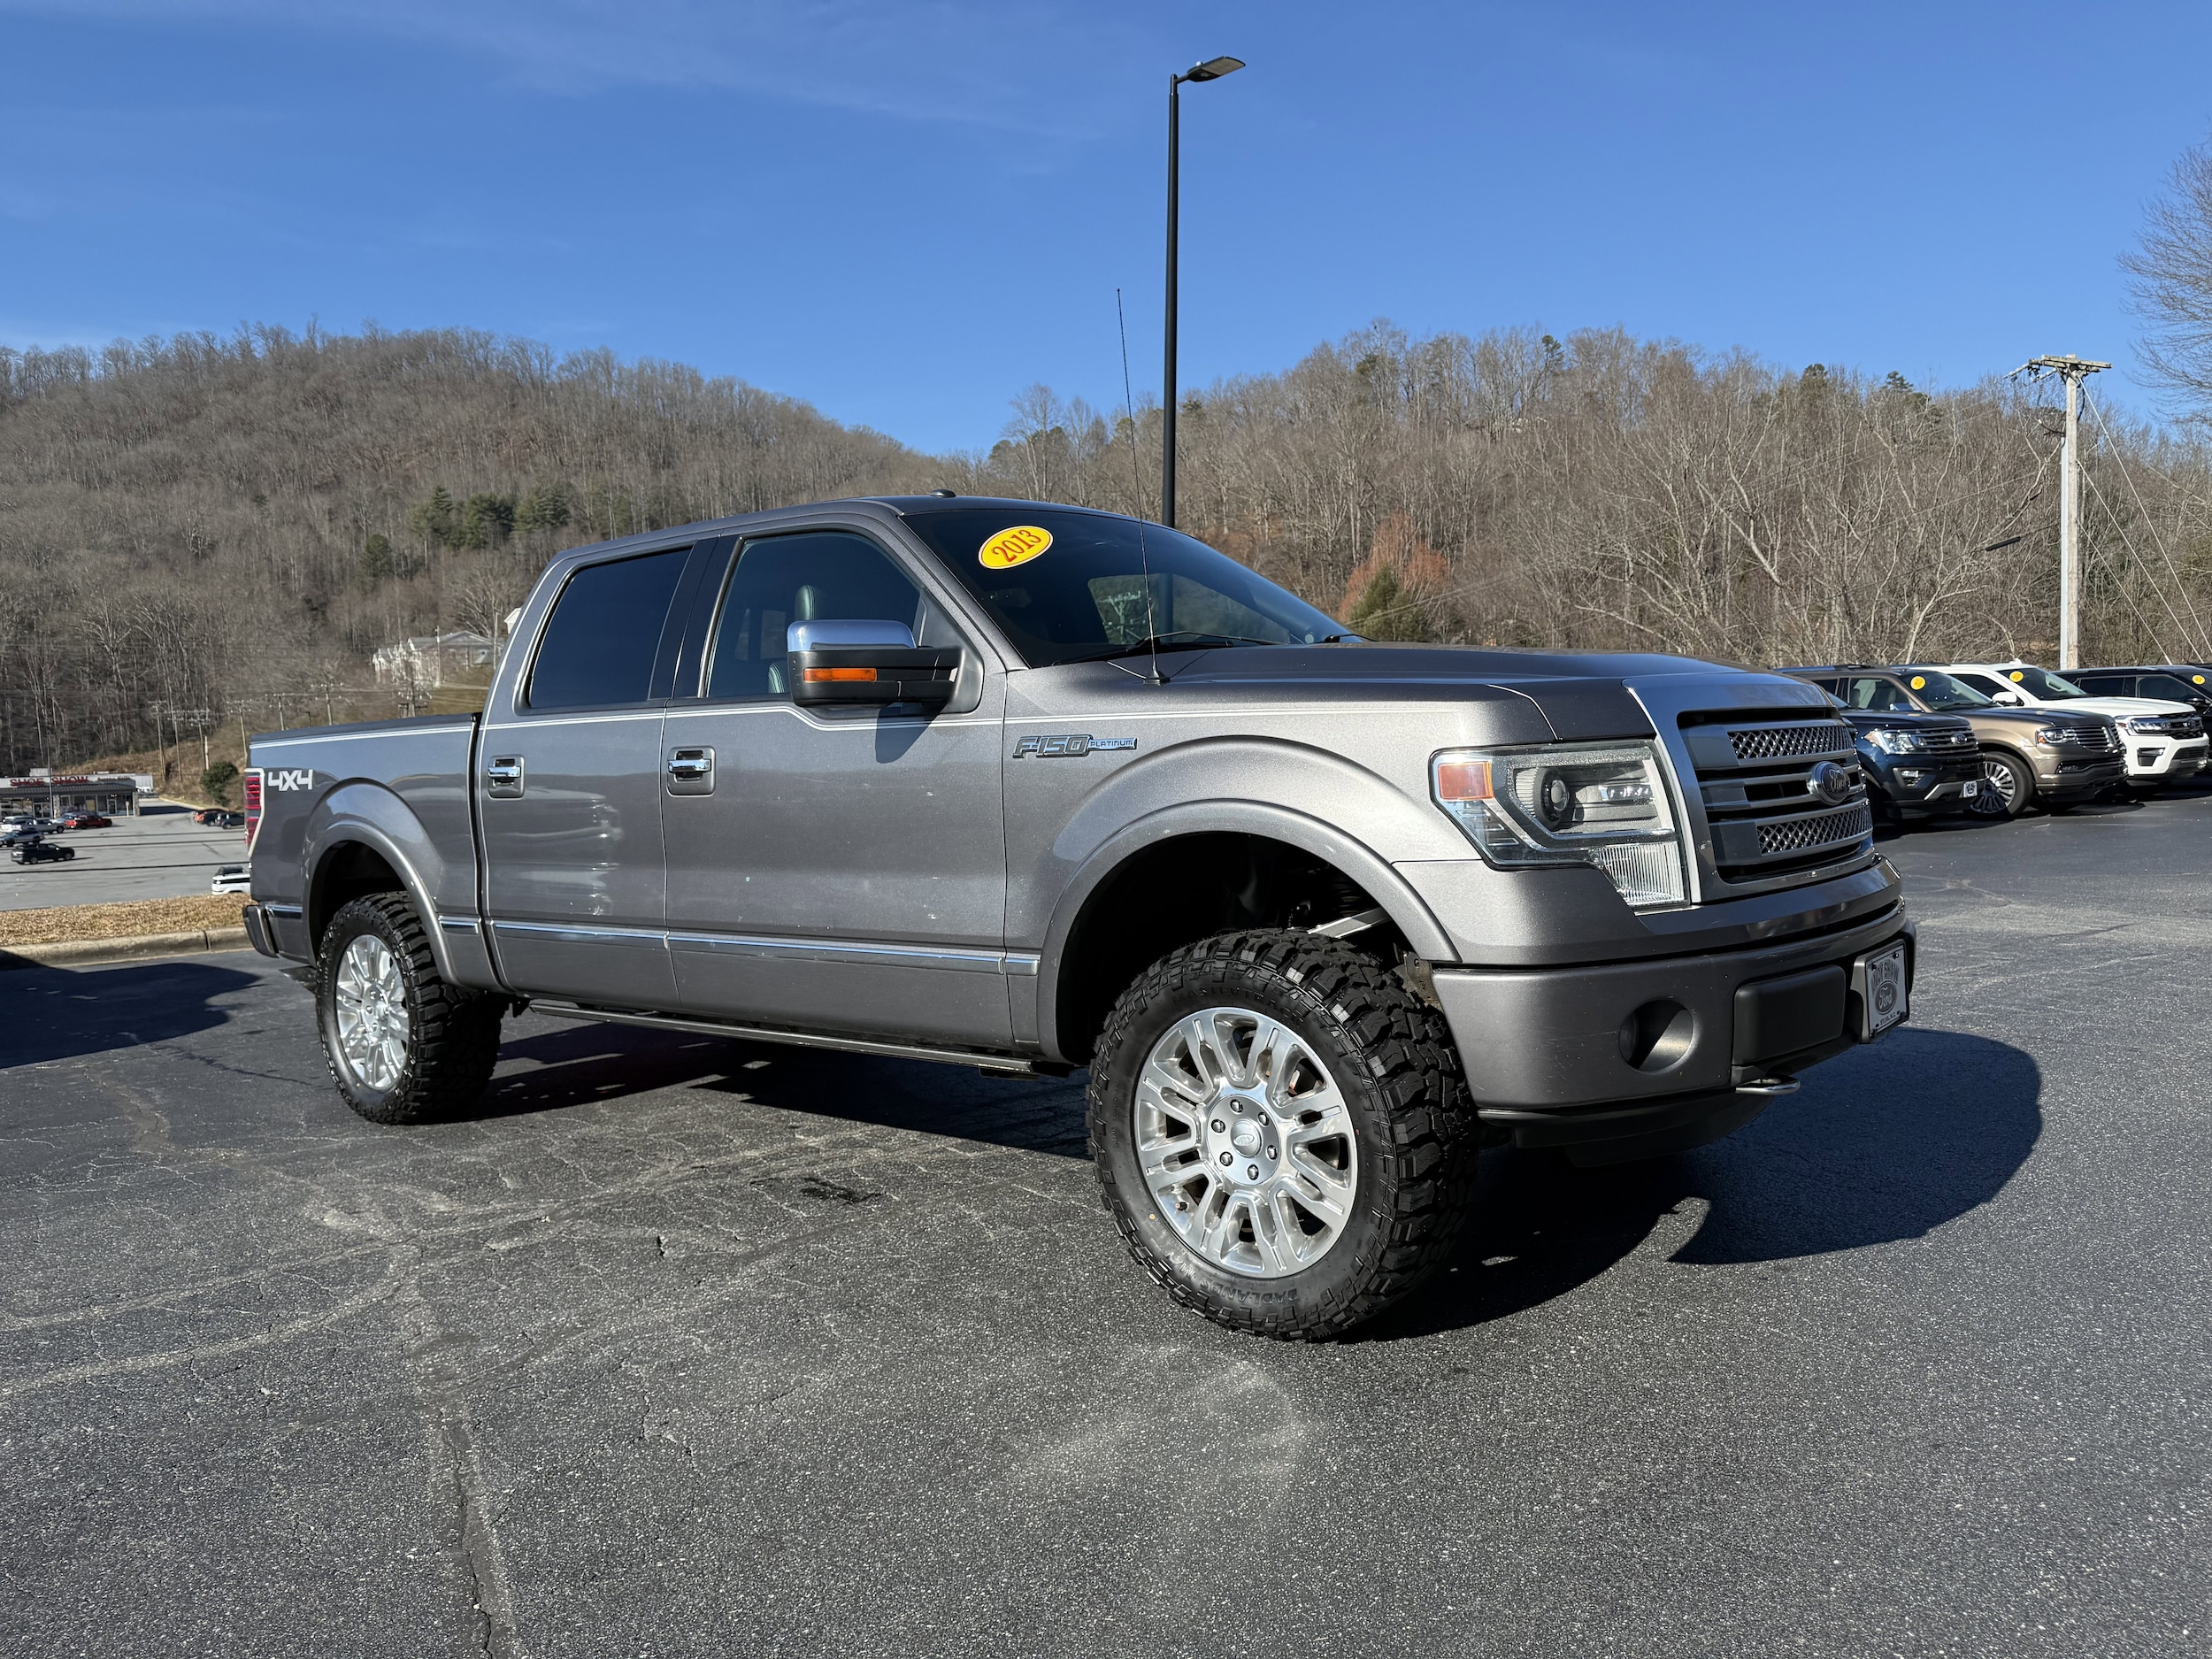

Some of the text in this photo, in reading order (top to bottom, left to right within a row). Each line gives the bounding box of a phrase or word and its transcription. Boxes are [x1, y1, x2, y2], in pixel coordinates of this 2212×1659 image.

[991, 529, 1042, 563] 2013
[1013, 734, 1133, 758] F-150 PLATINUM
[51, 775, 88, 785] SHOW
[1199, 1277, 1298, 1305] BADLANDS
